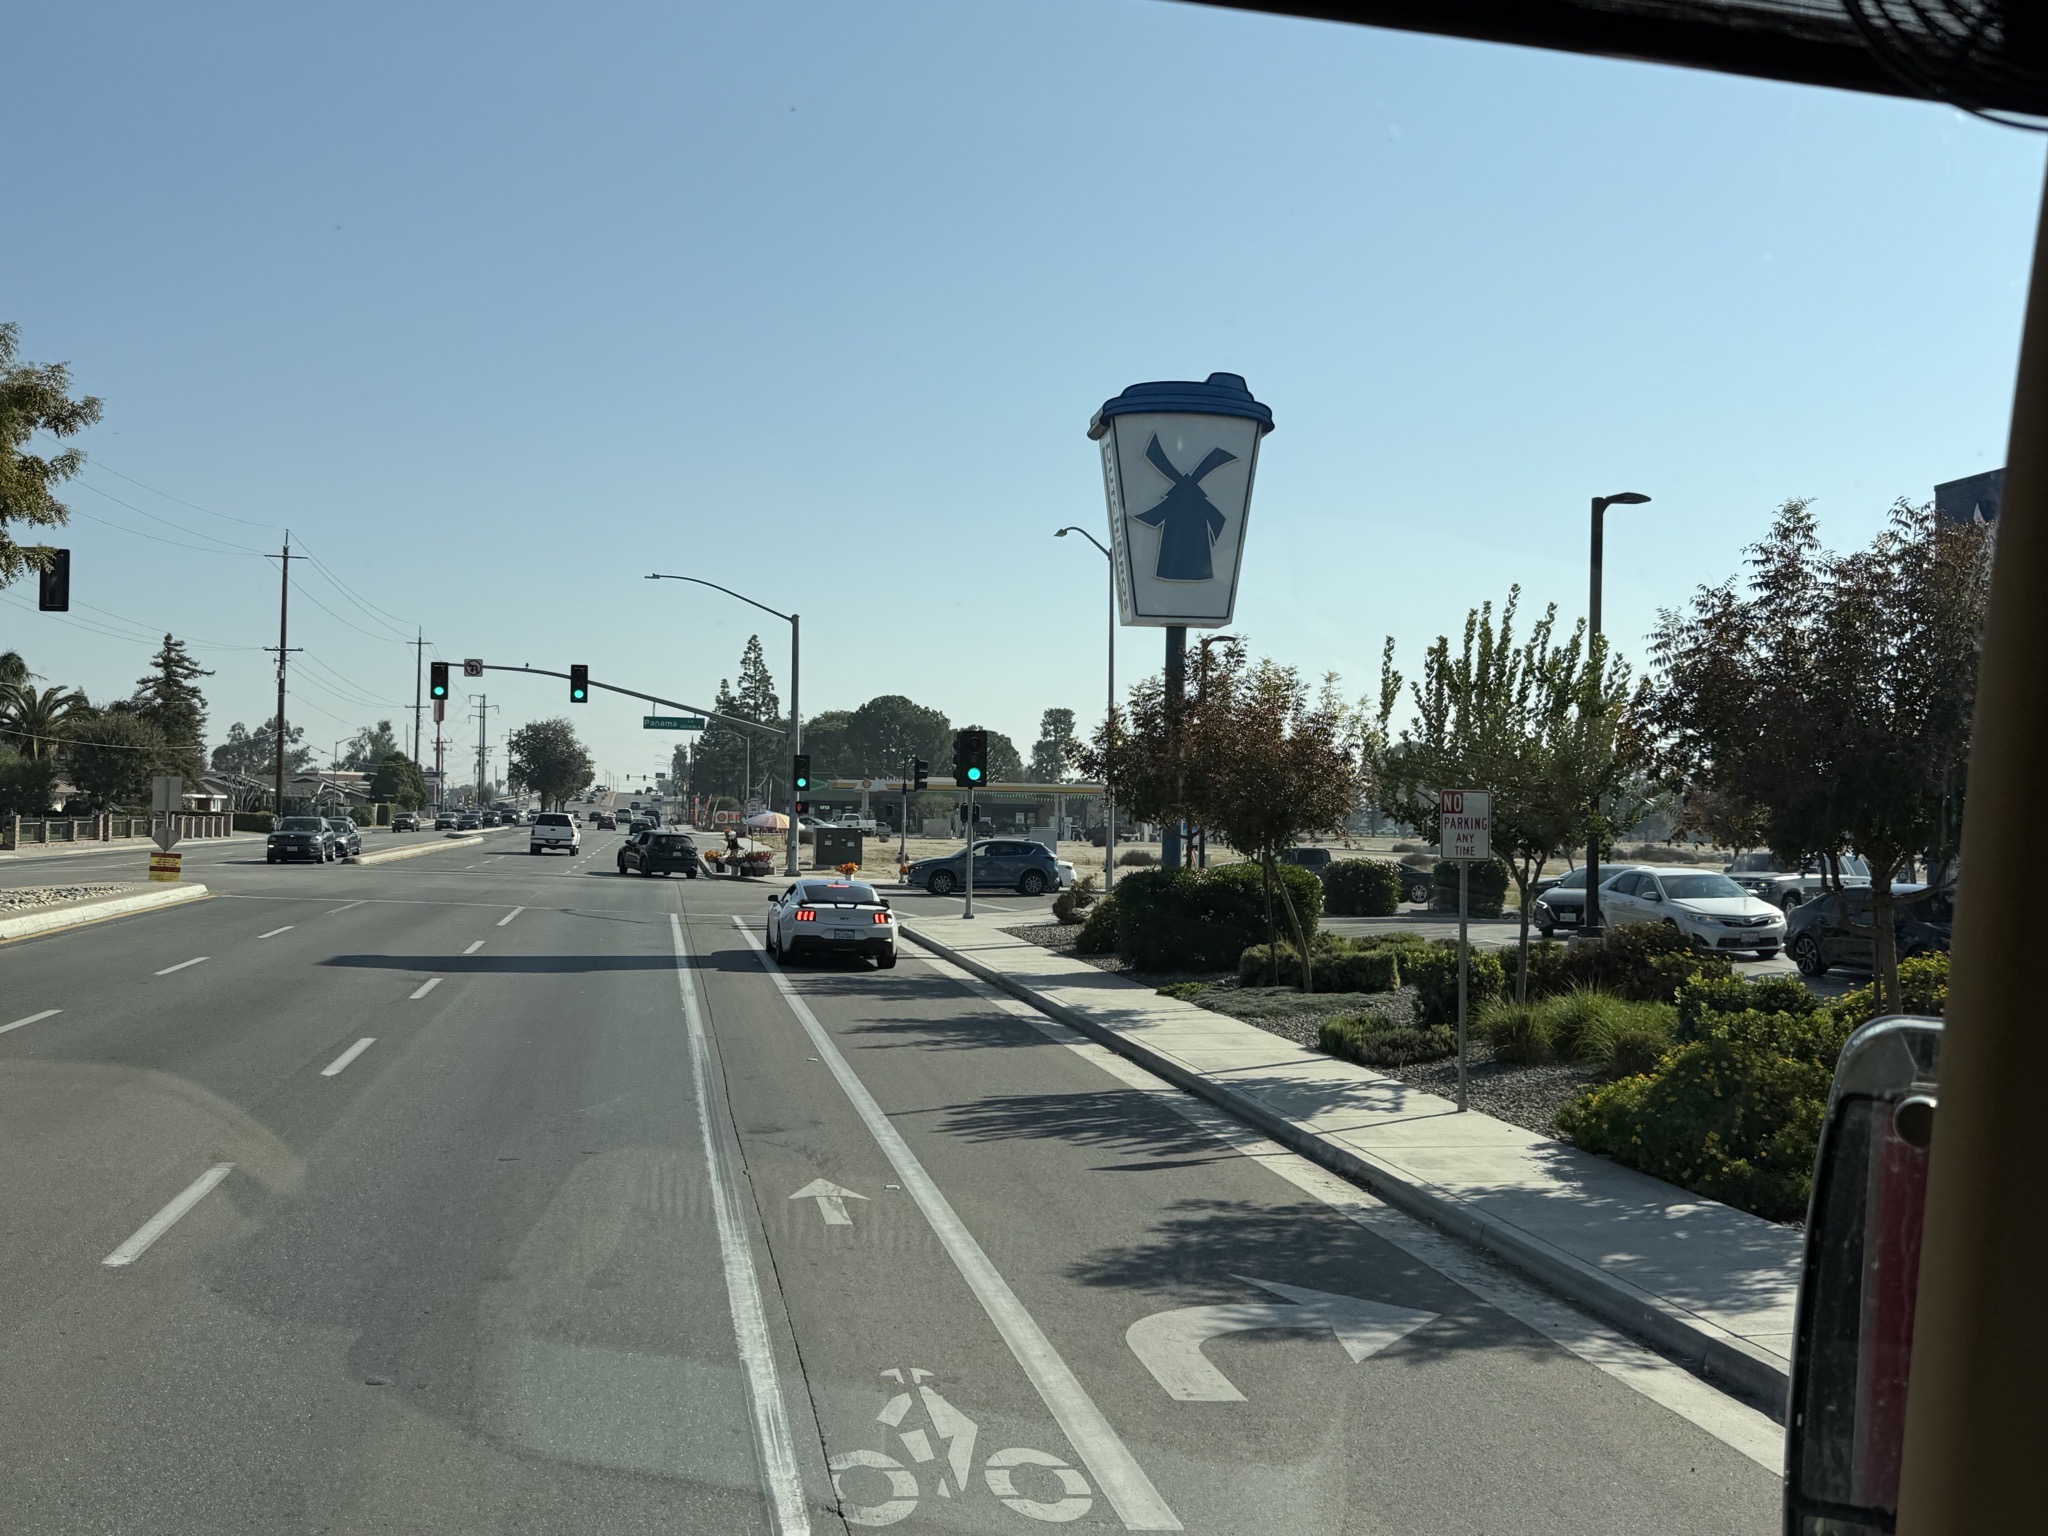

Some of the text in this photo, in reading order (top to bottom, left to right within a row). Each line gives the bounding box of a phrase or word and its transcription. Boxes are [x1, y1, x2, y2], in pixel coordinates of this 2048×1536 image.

[1105, 442, 1130, 613] DUTCH BROS
[644, 719, 678, 728] Panama
[1443, 794, 1462, 812] NO
[1444, 817, 1488, 831] PARKING
[1456, 833, 1475, 843] ANY
[1454, 846, 1476, 856] TIME
